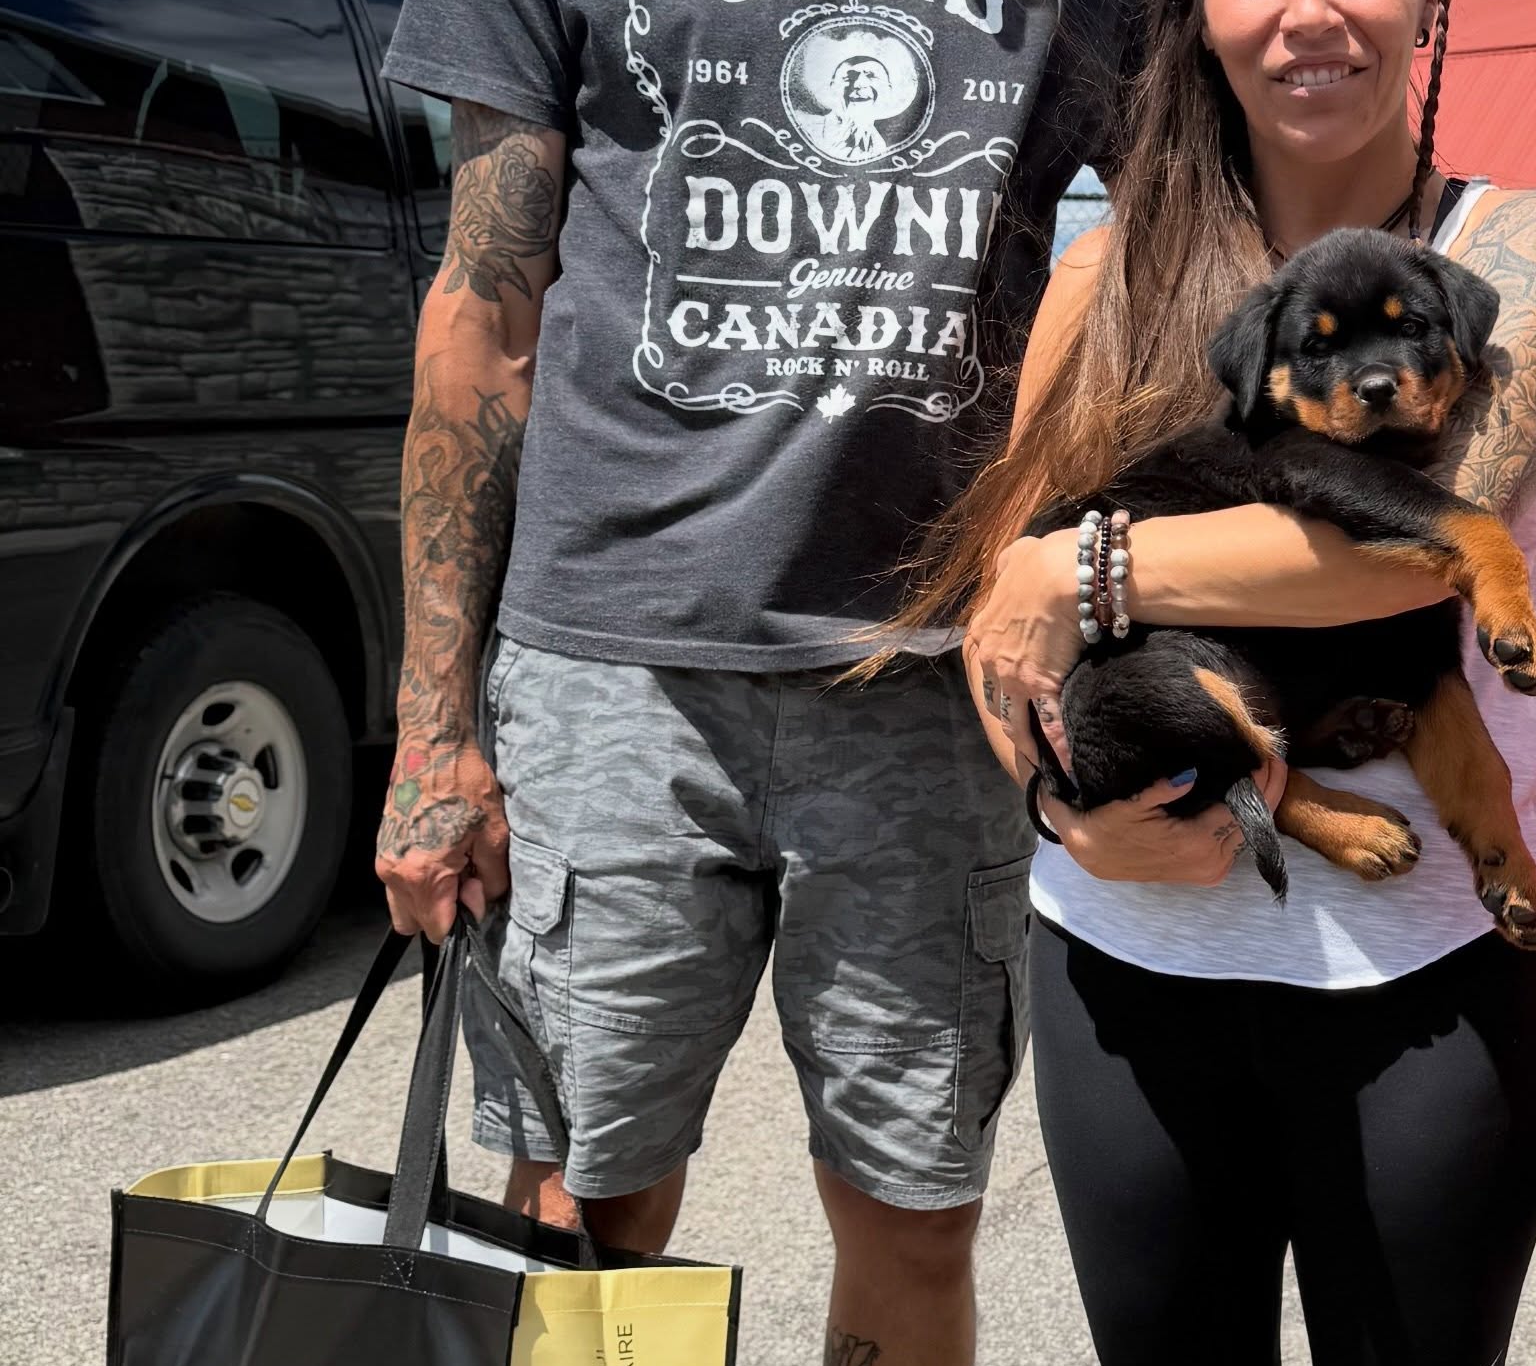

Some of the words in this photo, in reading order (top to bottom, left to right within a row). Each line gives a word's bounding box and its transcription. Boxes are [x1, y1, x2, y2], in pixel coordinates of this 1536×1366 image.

[687, 59, 749, 85] 1964
[963, 78, 1025, 106] 2017
[685, 175, 1002, 261] DOWNI
[786, 257, 915, 299] Genuine
[666, 300, 968, 359] CANADIA
[766, 357, 825, 377] ROCK
[866, 357, 931, 382] ROLL
